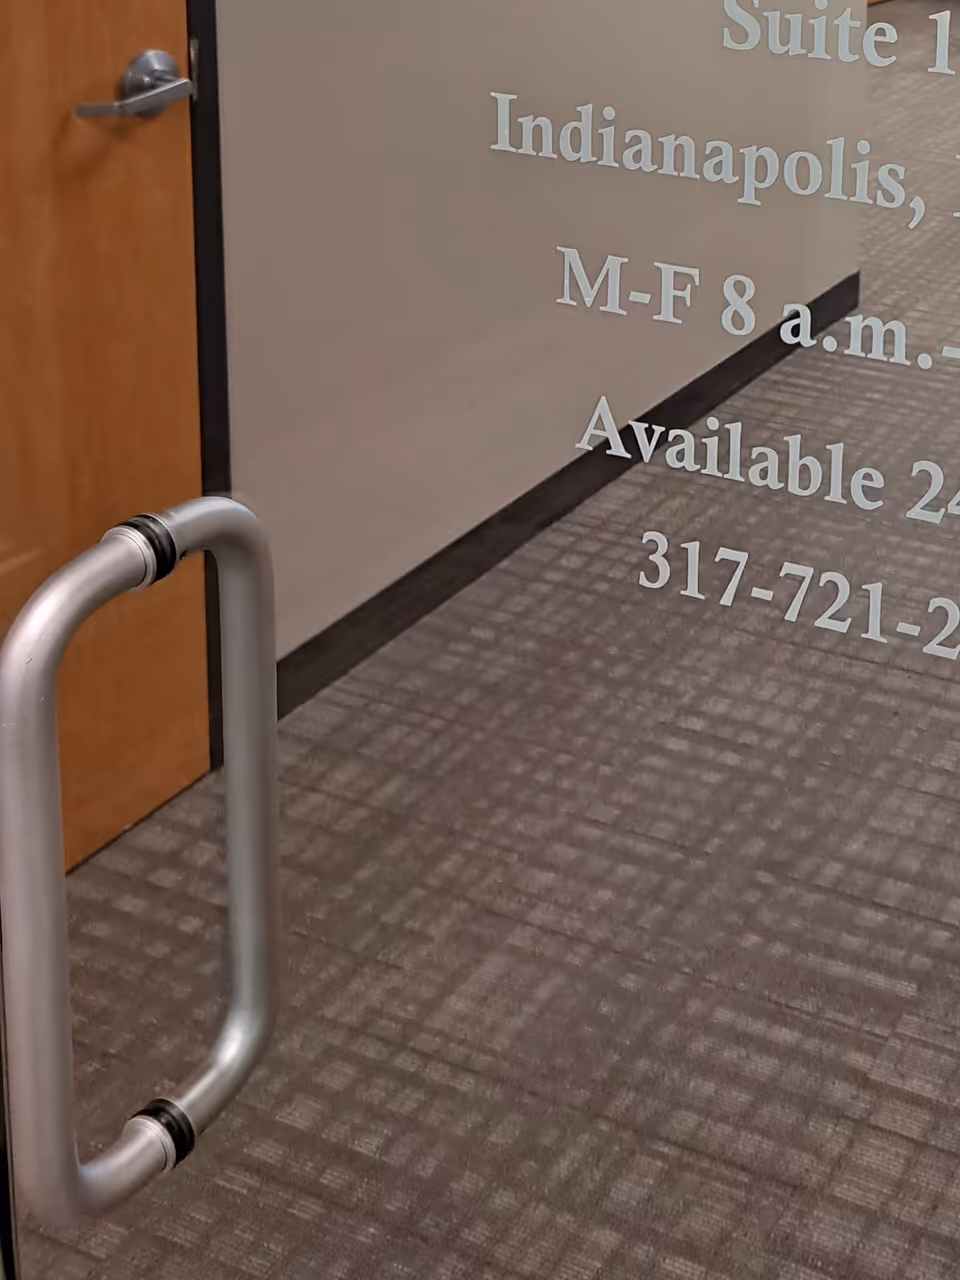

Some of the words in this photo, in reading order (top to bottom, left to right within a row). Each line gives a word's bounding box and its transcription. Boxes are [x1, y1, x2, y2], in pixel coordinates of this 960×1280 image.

[489, 92, 926, 230] Indianapolis,
[555, 246, 700, 325] M-F
[721, 275, 756, 337] 8
[574, 395, 886, 510] Available
